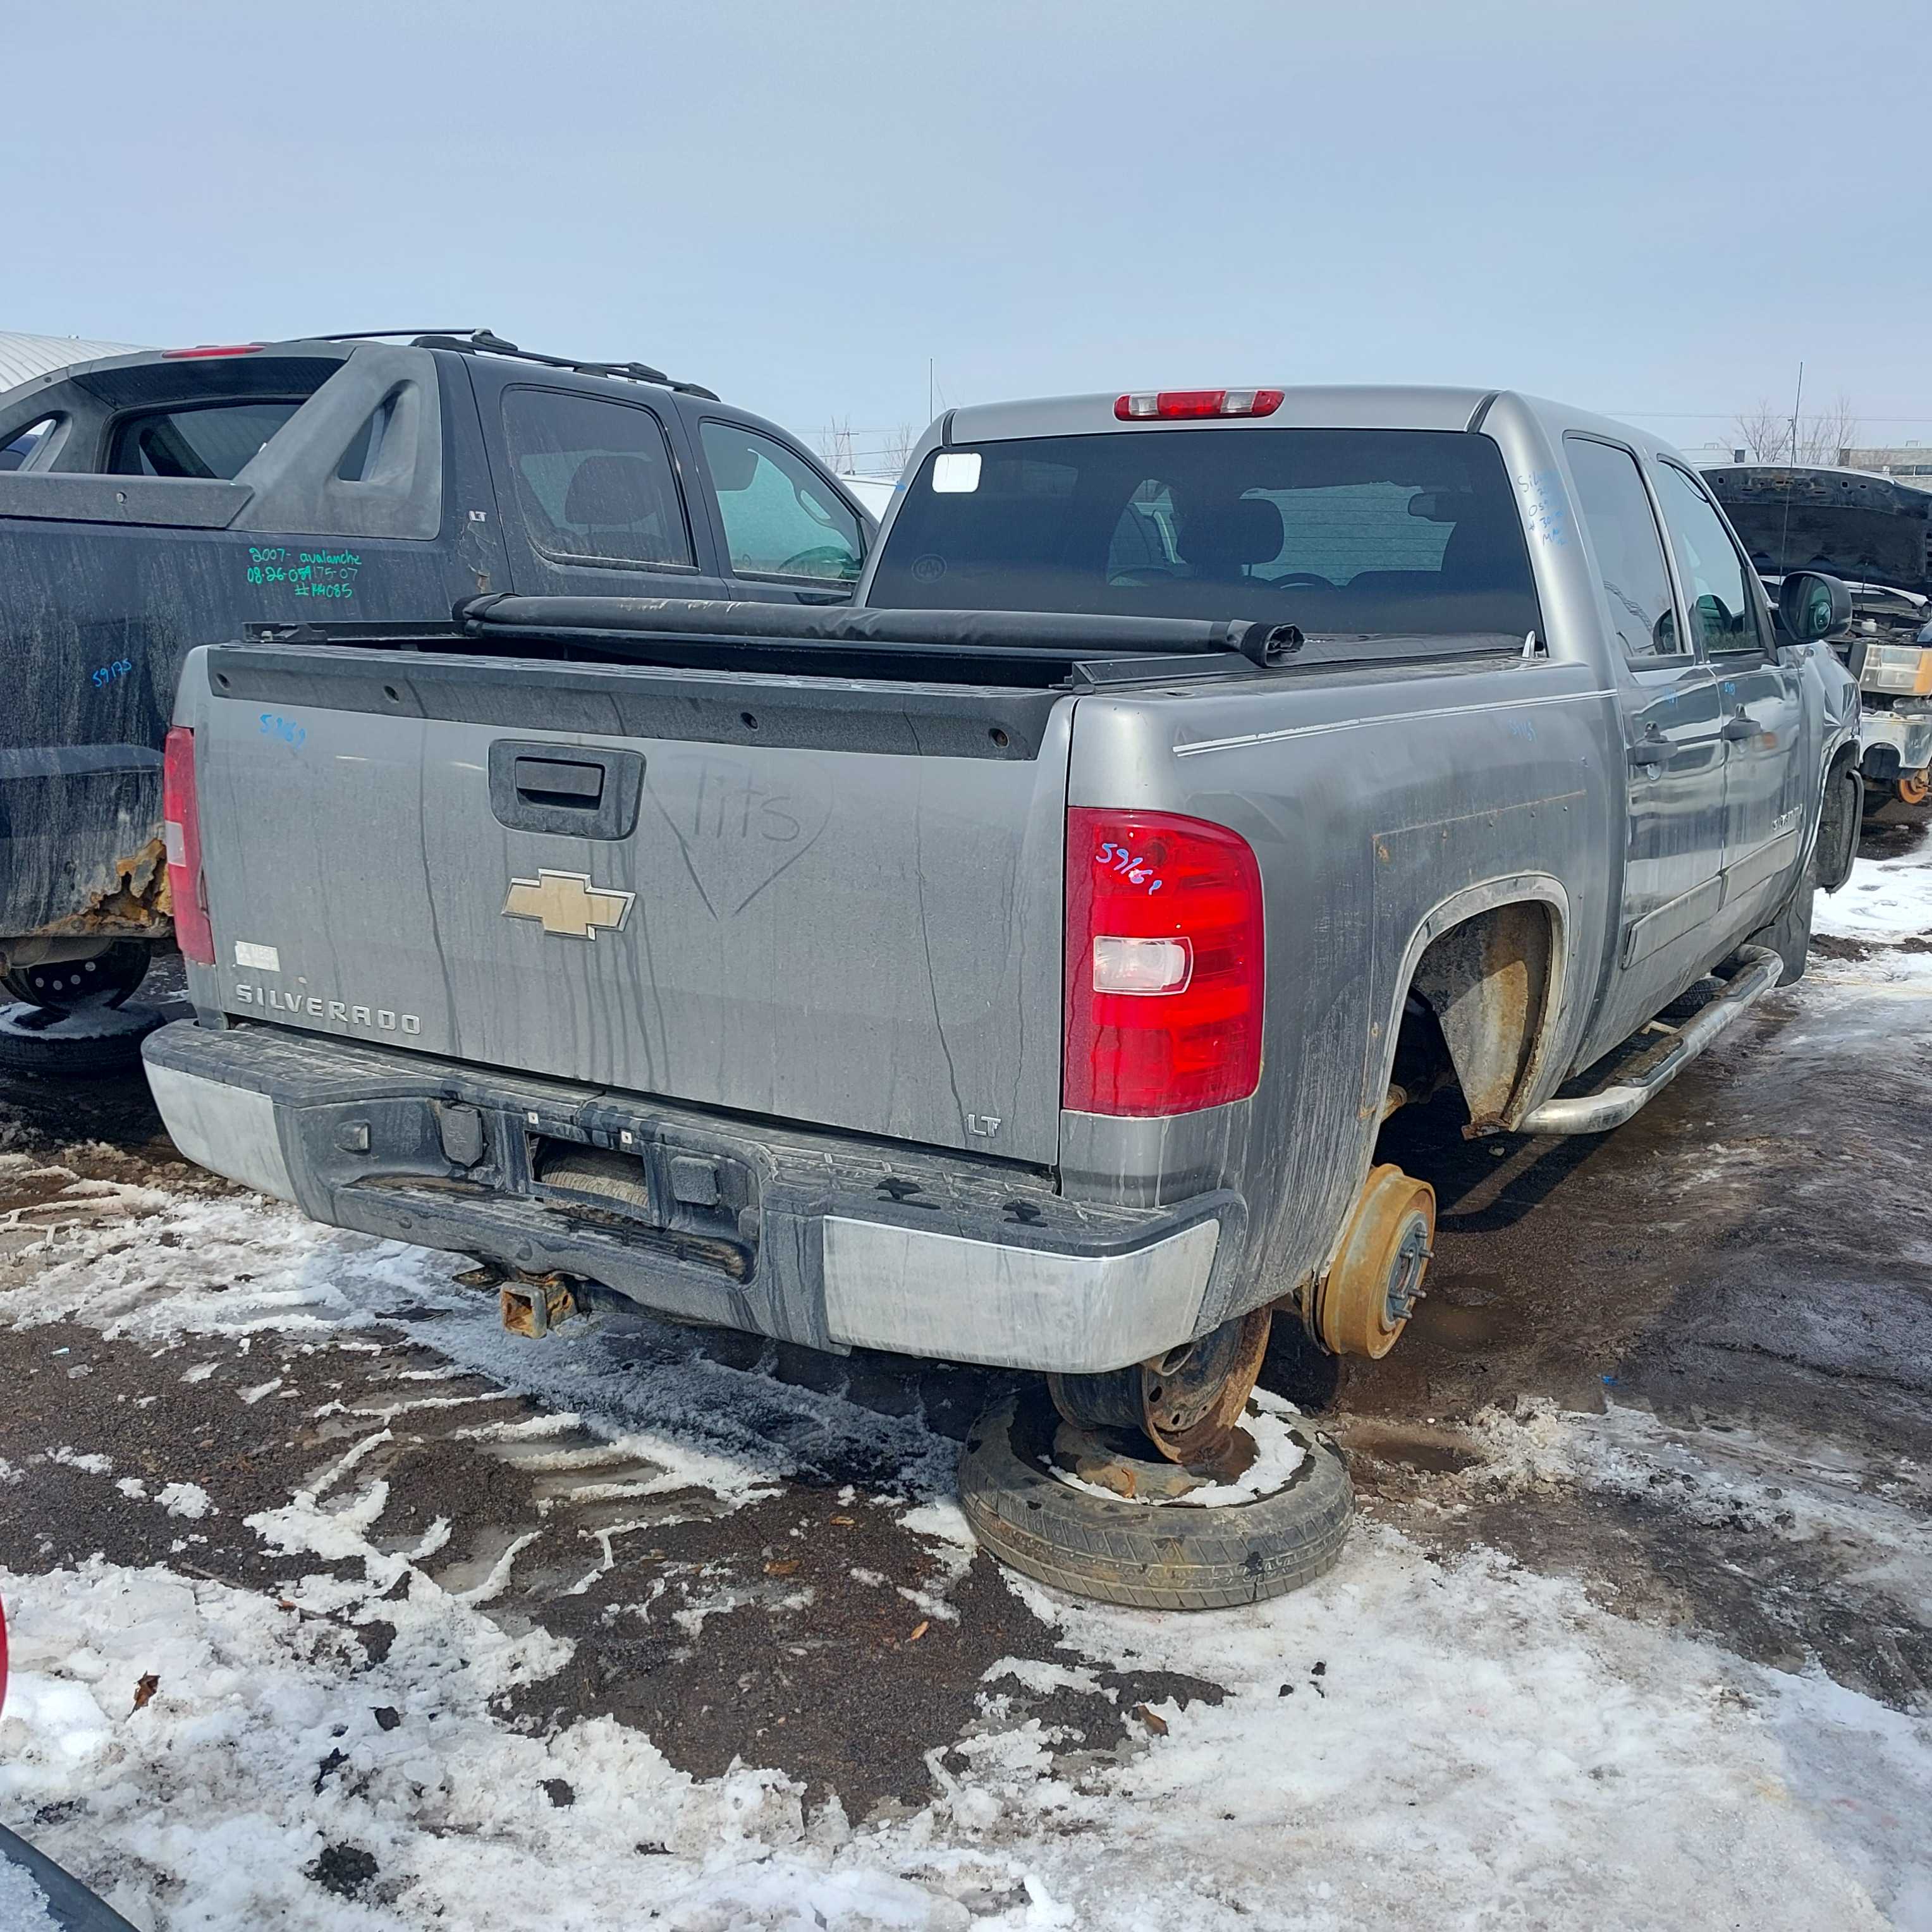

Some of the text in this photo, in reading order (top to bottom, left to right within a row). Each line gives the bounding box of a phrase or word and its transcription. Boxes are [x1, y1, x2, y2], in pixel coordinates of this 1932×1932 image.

[468, 510, 487, 522] LT
[300, 549, 362, 565] avalanche
[236, 984, 421, 1035] SILVERADO
[968, 1114, 1001, 1137] LT
